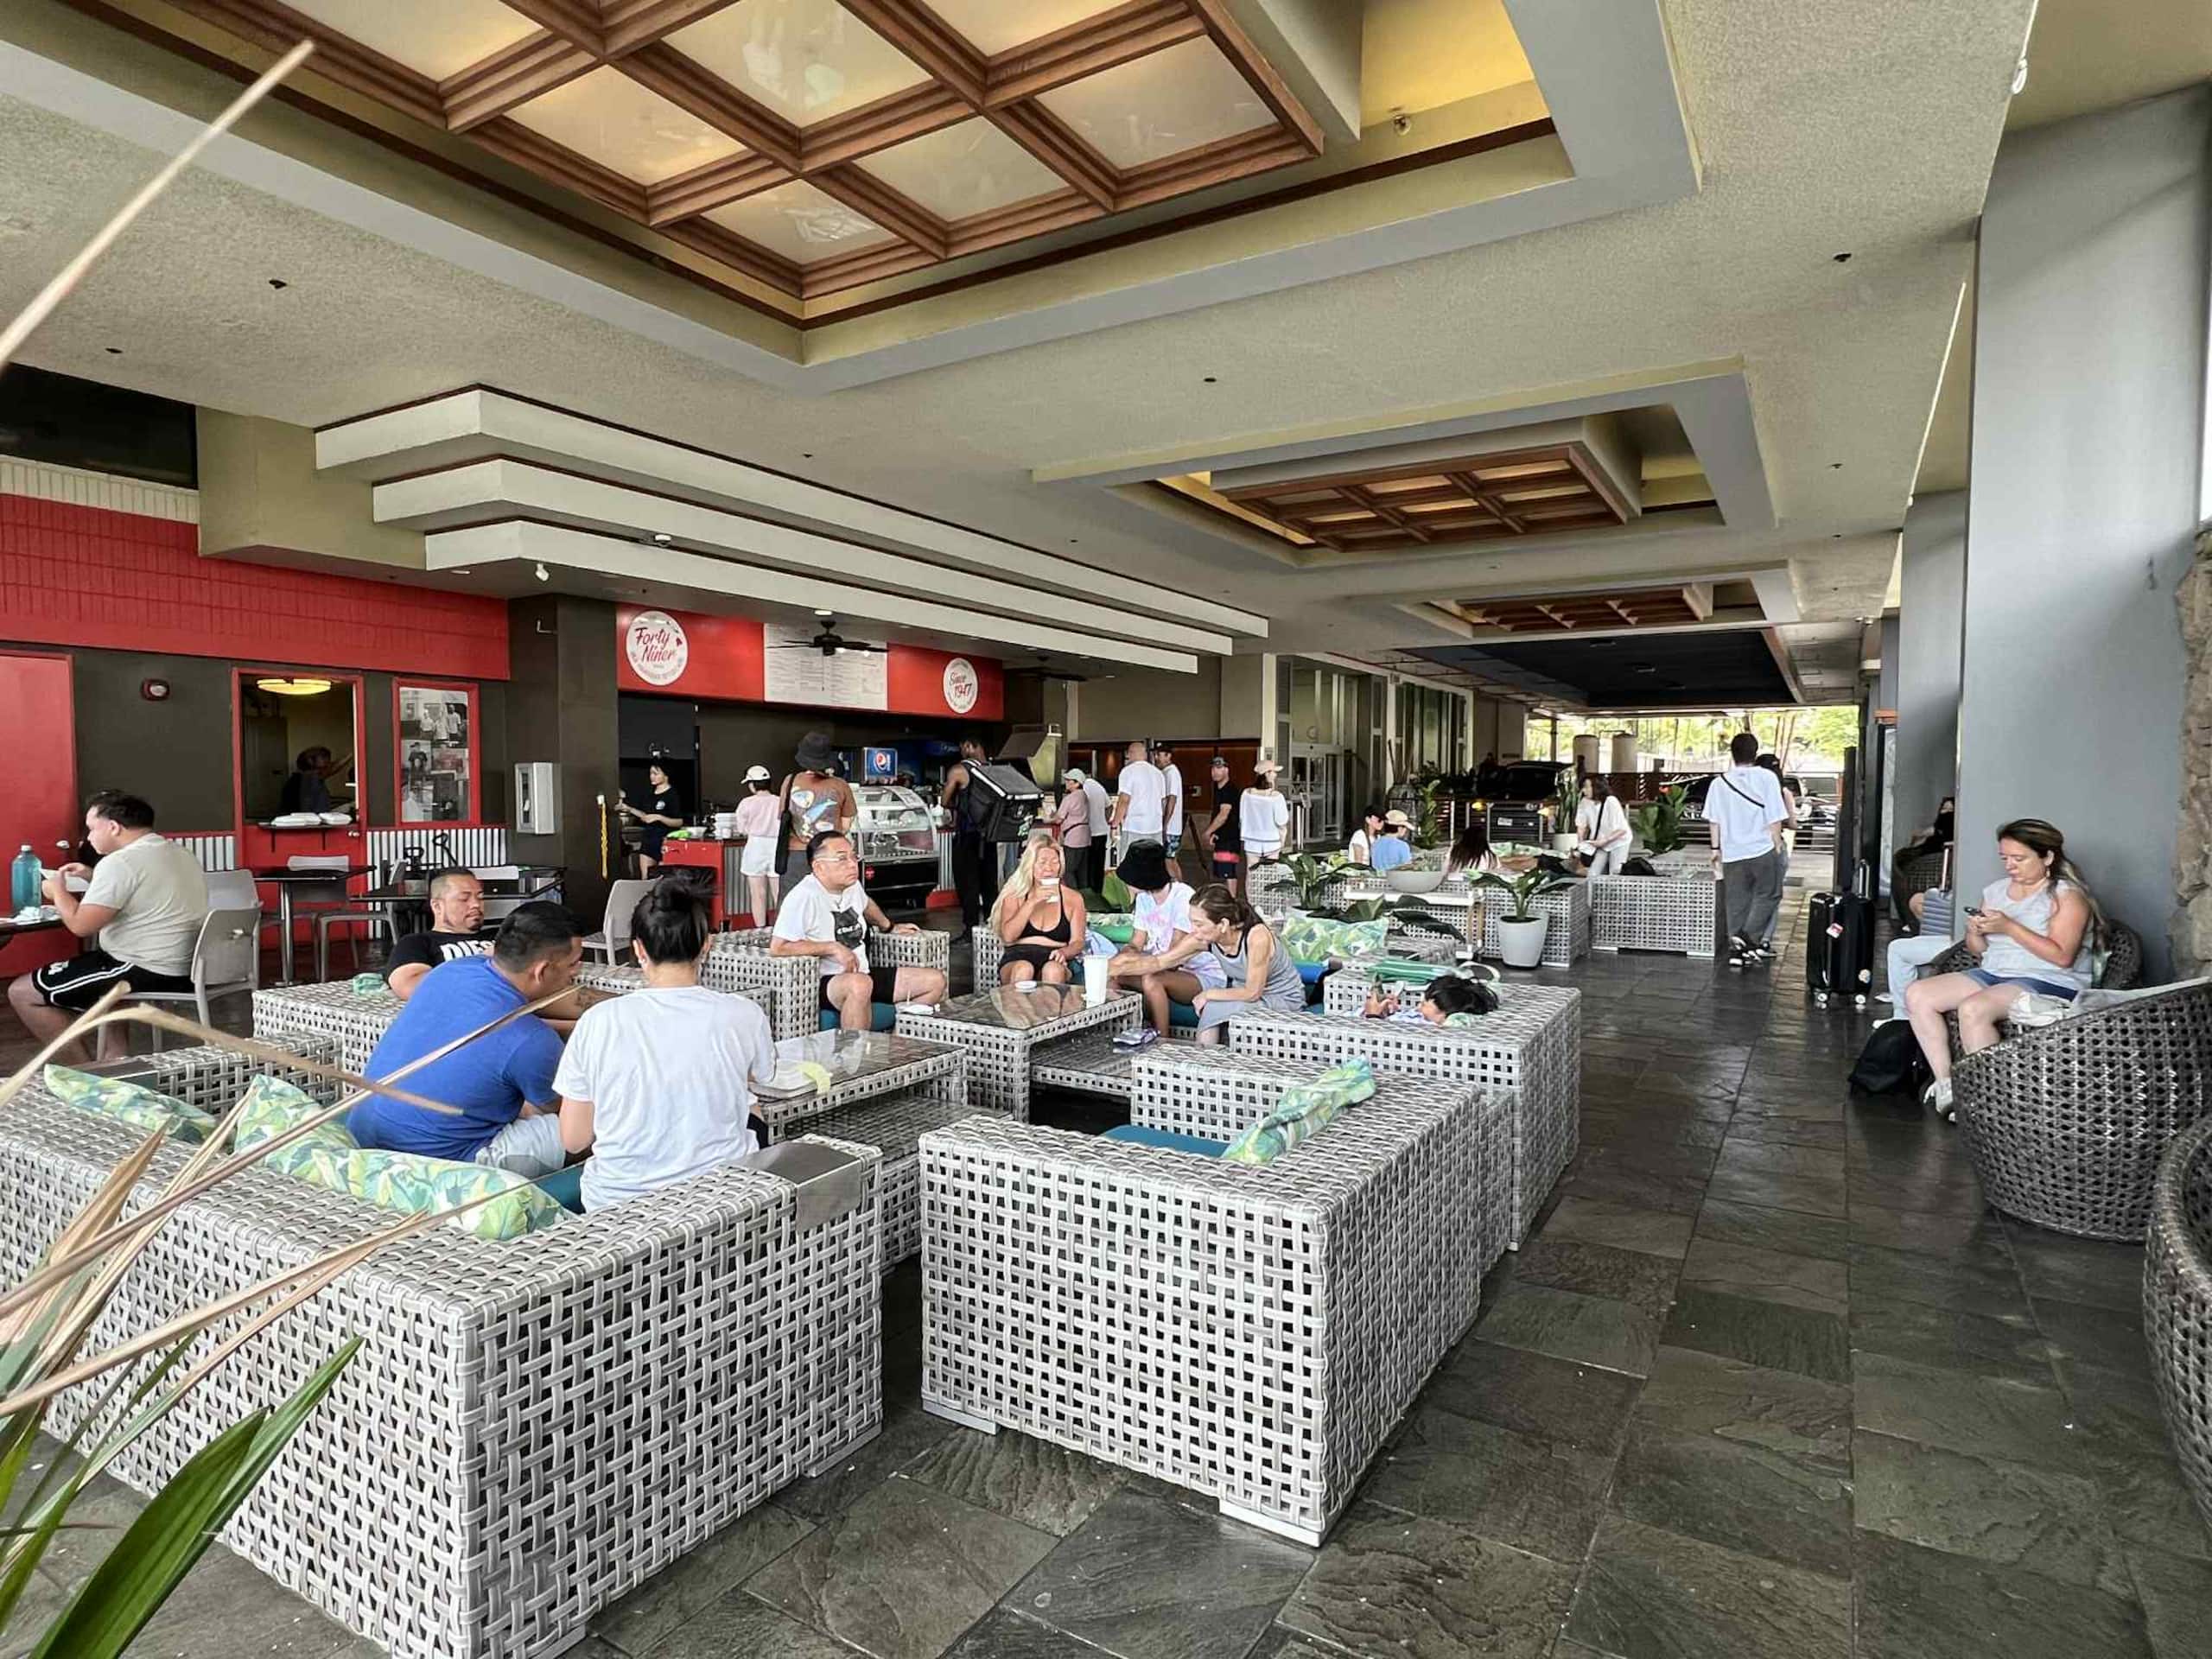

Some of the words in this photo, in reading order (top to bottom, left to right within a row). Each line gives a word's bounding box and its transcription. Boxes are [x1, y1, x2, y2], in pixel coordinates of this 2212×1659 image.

[634, 626, 671, 650] Forty
[642, 645, 675, 663] Niner
[439, 940, 497, 961] DIES
